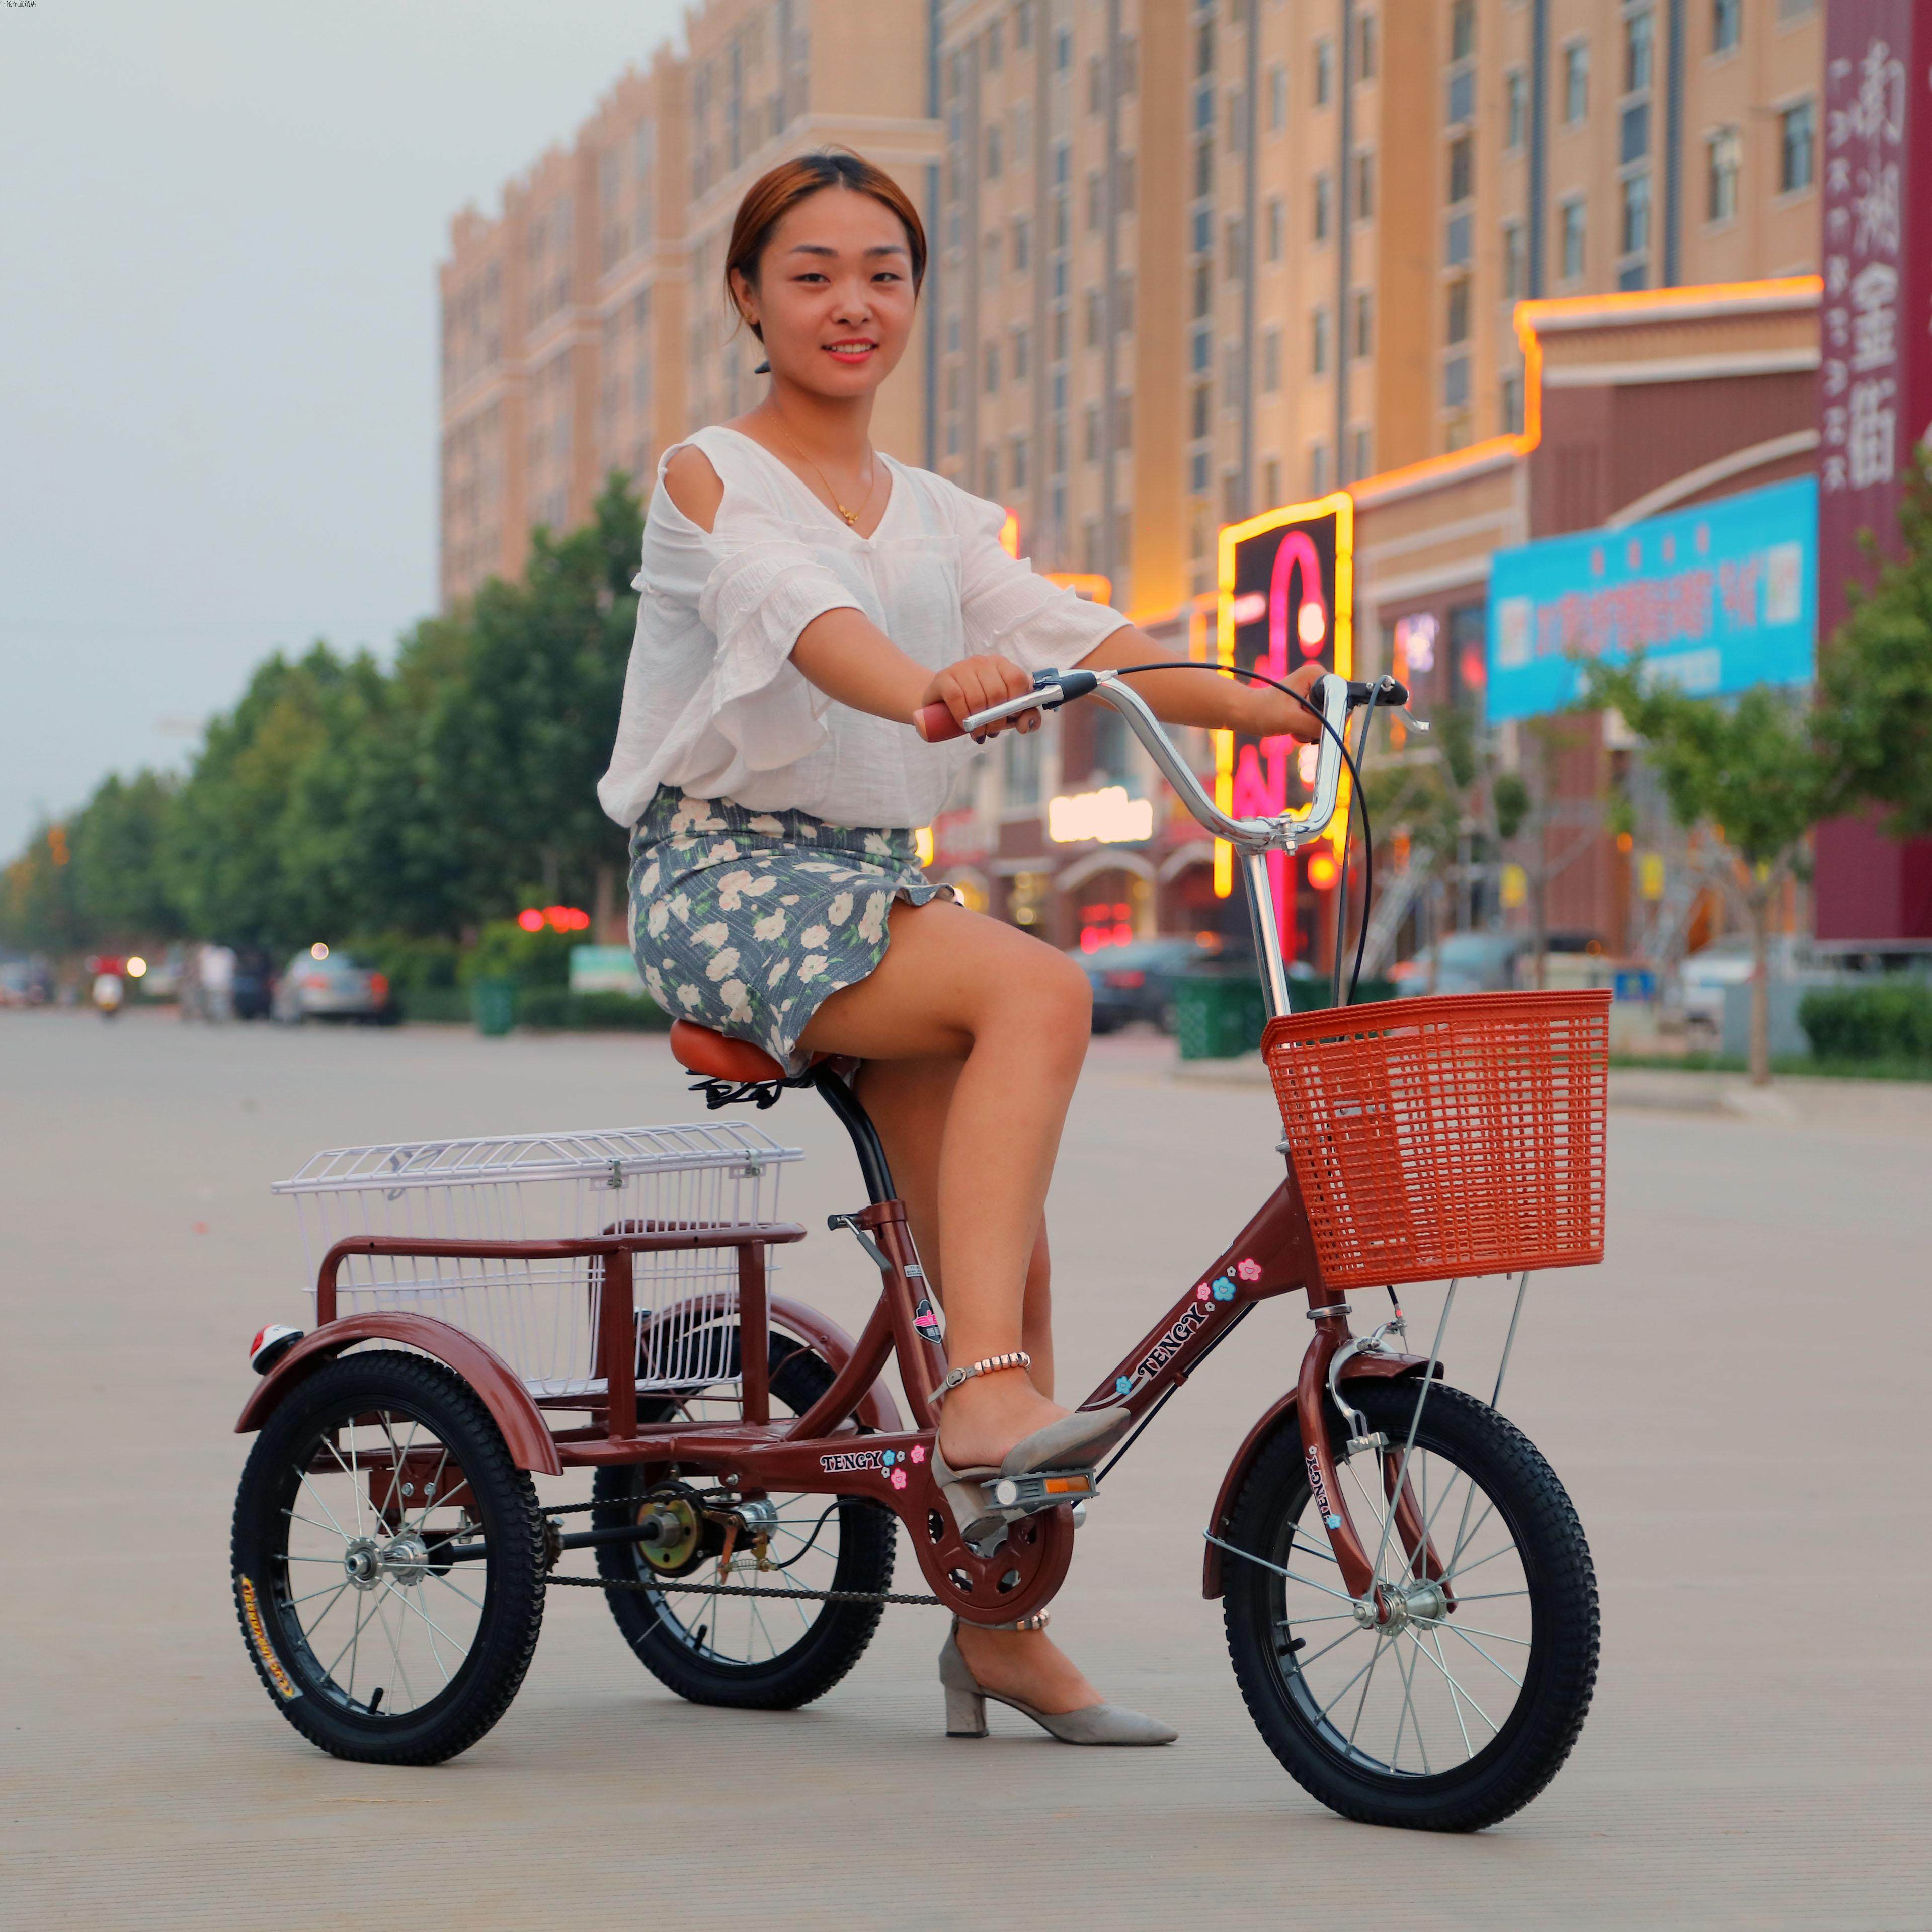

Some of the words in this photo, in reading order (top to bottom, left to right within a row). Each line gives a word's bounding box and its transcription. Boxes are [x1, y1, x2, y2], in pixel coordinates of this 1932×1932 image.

[1136, 1303, 1208, 1379] TENGY
[821, 1451, 881, 1472] TENGY
[1306, 1455, 1333, 1523] TENGY
